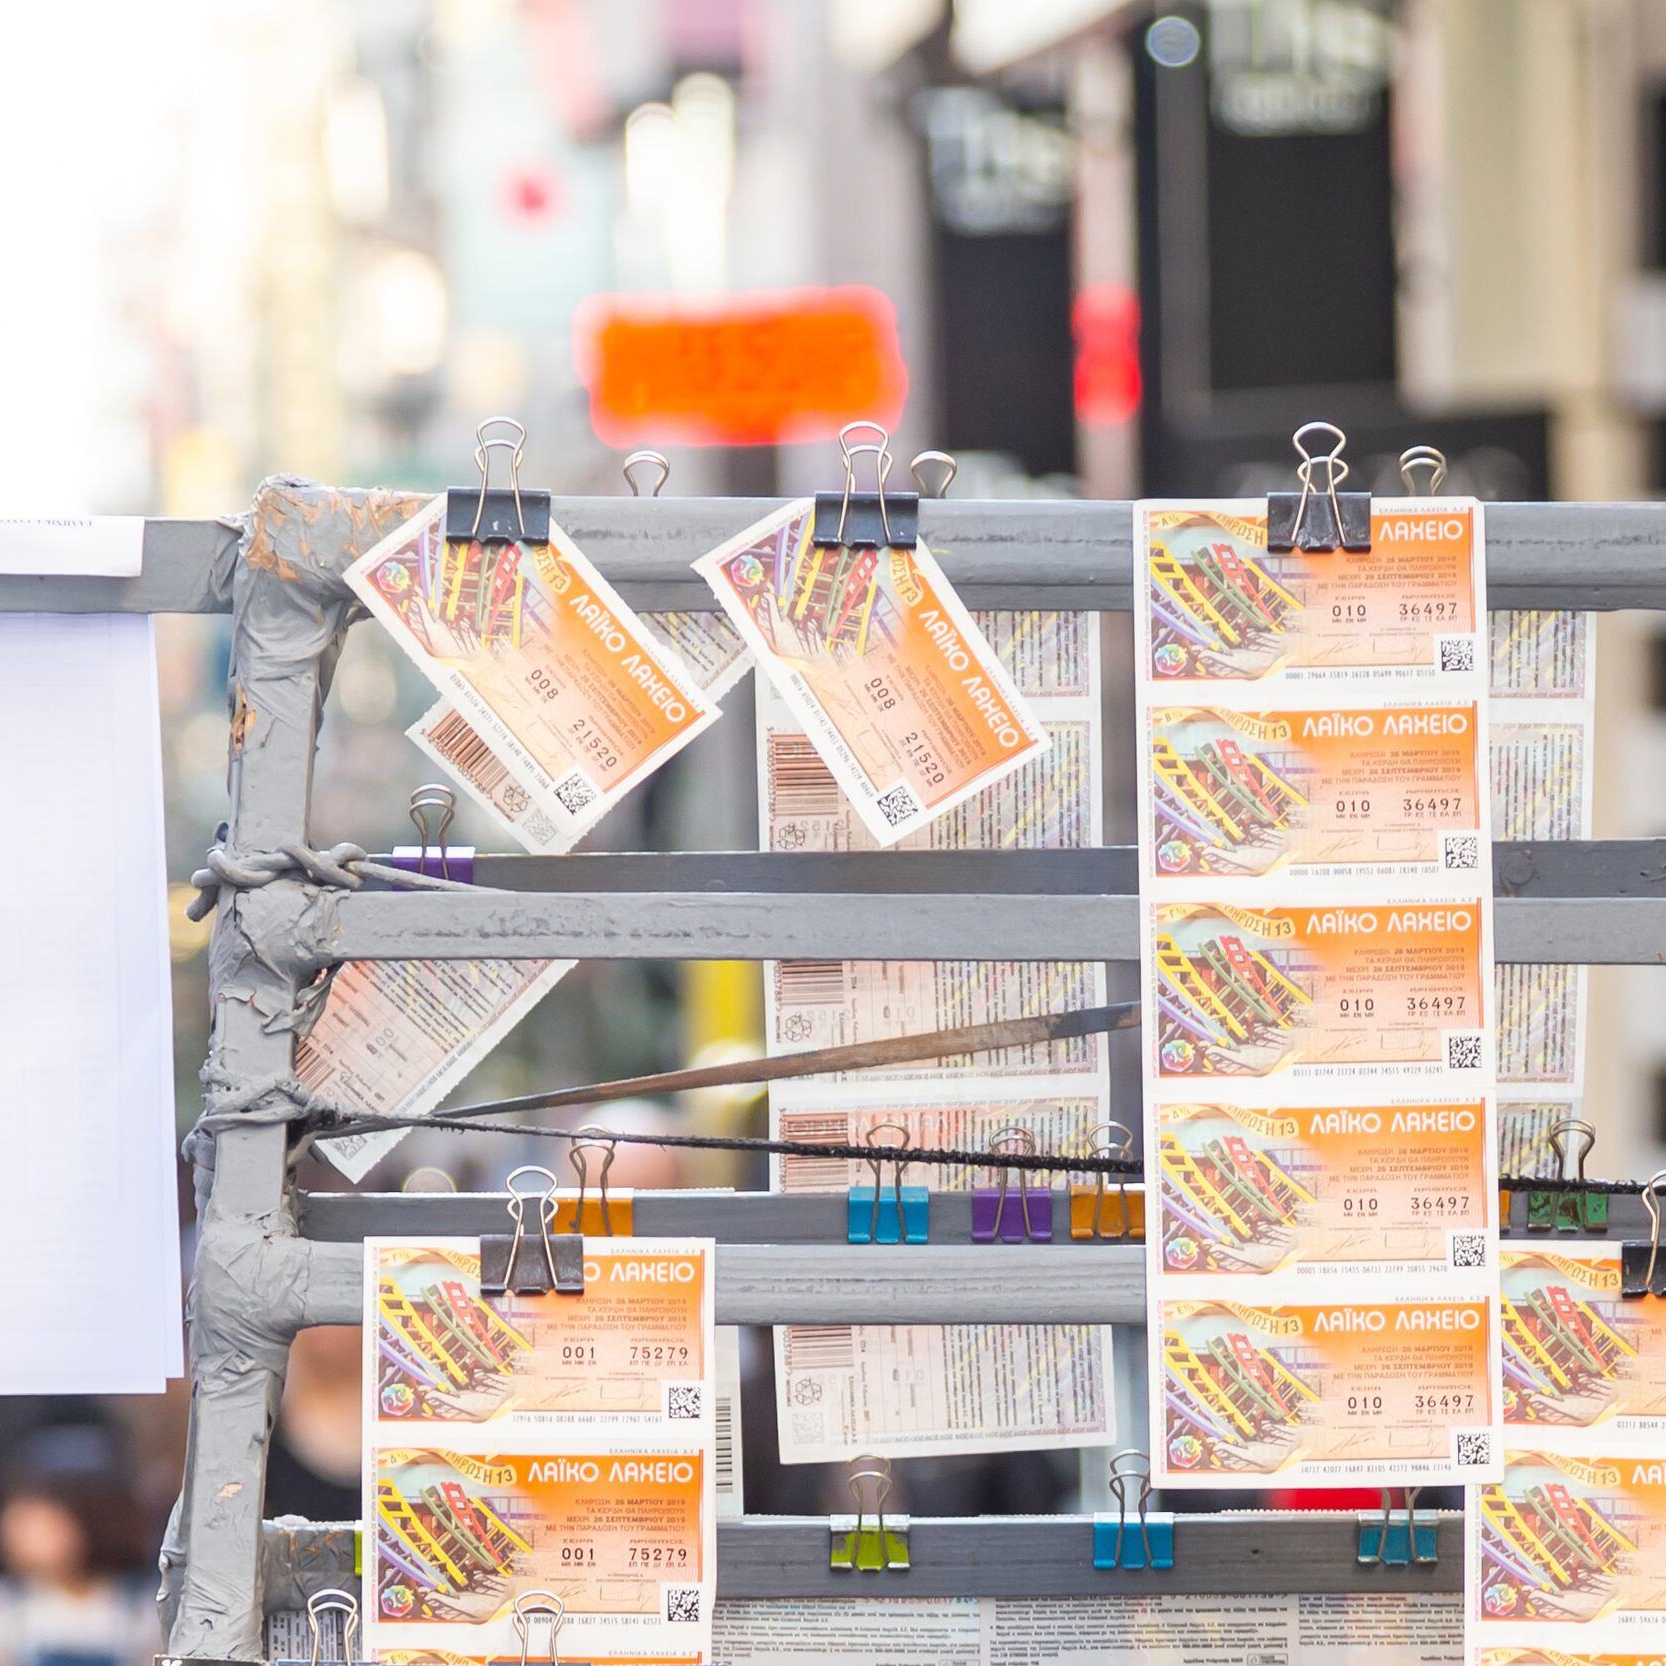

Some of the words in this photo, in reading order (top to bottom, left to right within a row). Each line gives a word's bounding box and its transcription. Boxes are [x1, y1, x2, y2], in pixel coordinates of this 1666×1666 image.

[1379, 520, 1463, 544] ΛΑΧΕΙΟ
[1332, 605, 1367, 617] 010
[1398, 602, 1458, 616] 36497
[568, 593, 628, 651] ΛΑΪΚΟ
[622, 654, 687, 724] ΛΑΧΕΙΟ
[918, 609, 968, 669] ΛΑΪΚΟ
[962, 672, 1021, 748] ΛΑΧΕΙΟ
[529, 669, 559, 702] 008
[573, 717, 618, 771] 21520
[868, 676, 899, 713] 008
[903, 730, 945, 785] 21520
[1302, 714, 1374, 738] ΛΑΪΚΟ
[1383, 712, 1467, 736] ΛΑΧΕΙΟ
[1335, 801, 1371, 812] 010
[1402, 798, 1462, 812] 36497
[1310, 1110, 1381, 1133] ΛΑΪΚΟ
[1391, 1111, 1475, 1132] ΛΑΧΕΙΟ
[1344, 1199, 1378, 1211] 010
[1411, 1197, 1469, 1210] 36497
[610, 1262, 694, 1283] ΛΑΧΕΙΟ
[562, 1347, 595, 1358] 001
[630, 1347, 688, 1358] 75279
[528, 1461, 599, 1482] ΛΑΪΚΟ
[609, 1462, 693, 1483] ΛΑΧΕΙΟ
[562, 1549, 595, 1559] 001
[629, 1548, 687, 1560] 75279
